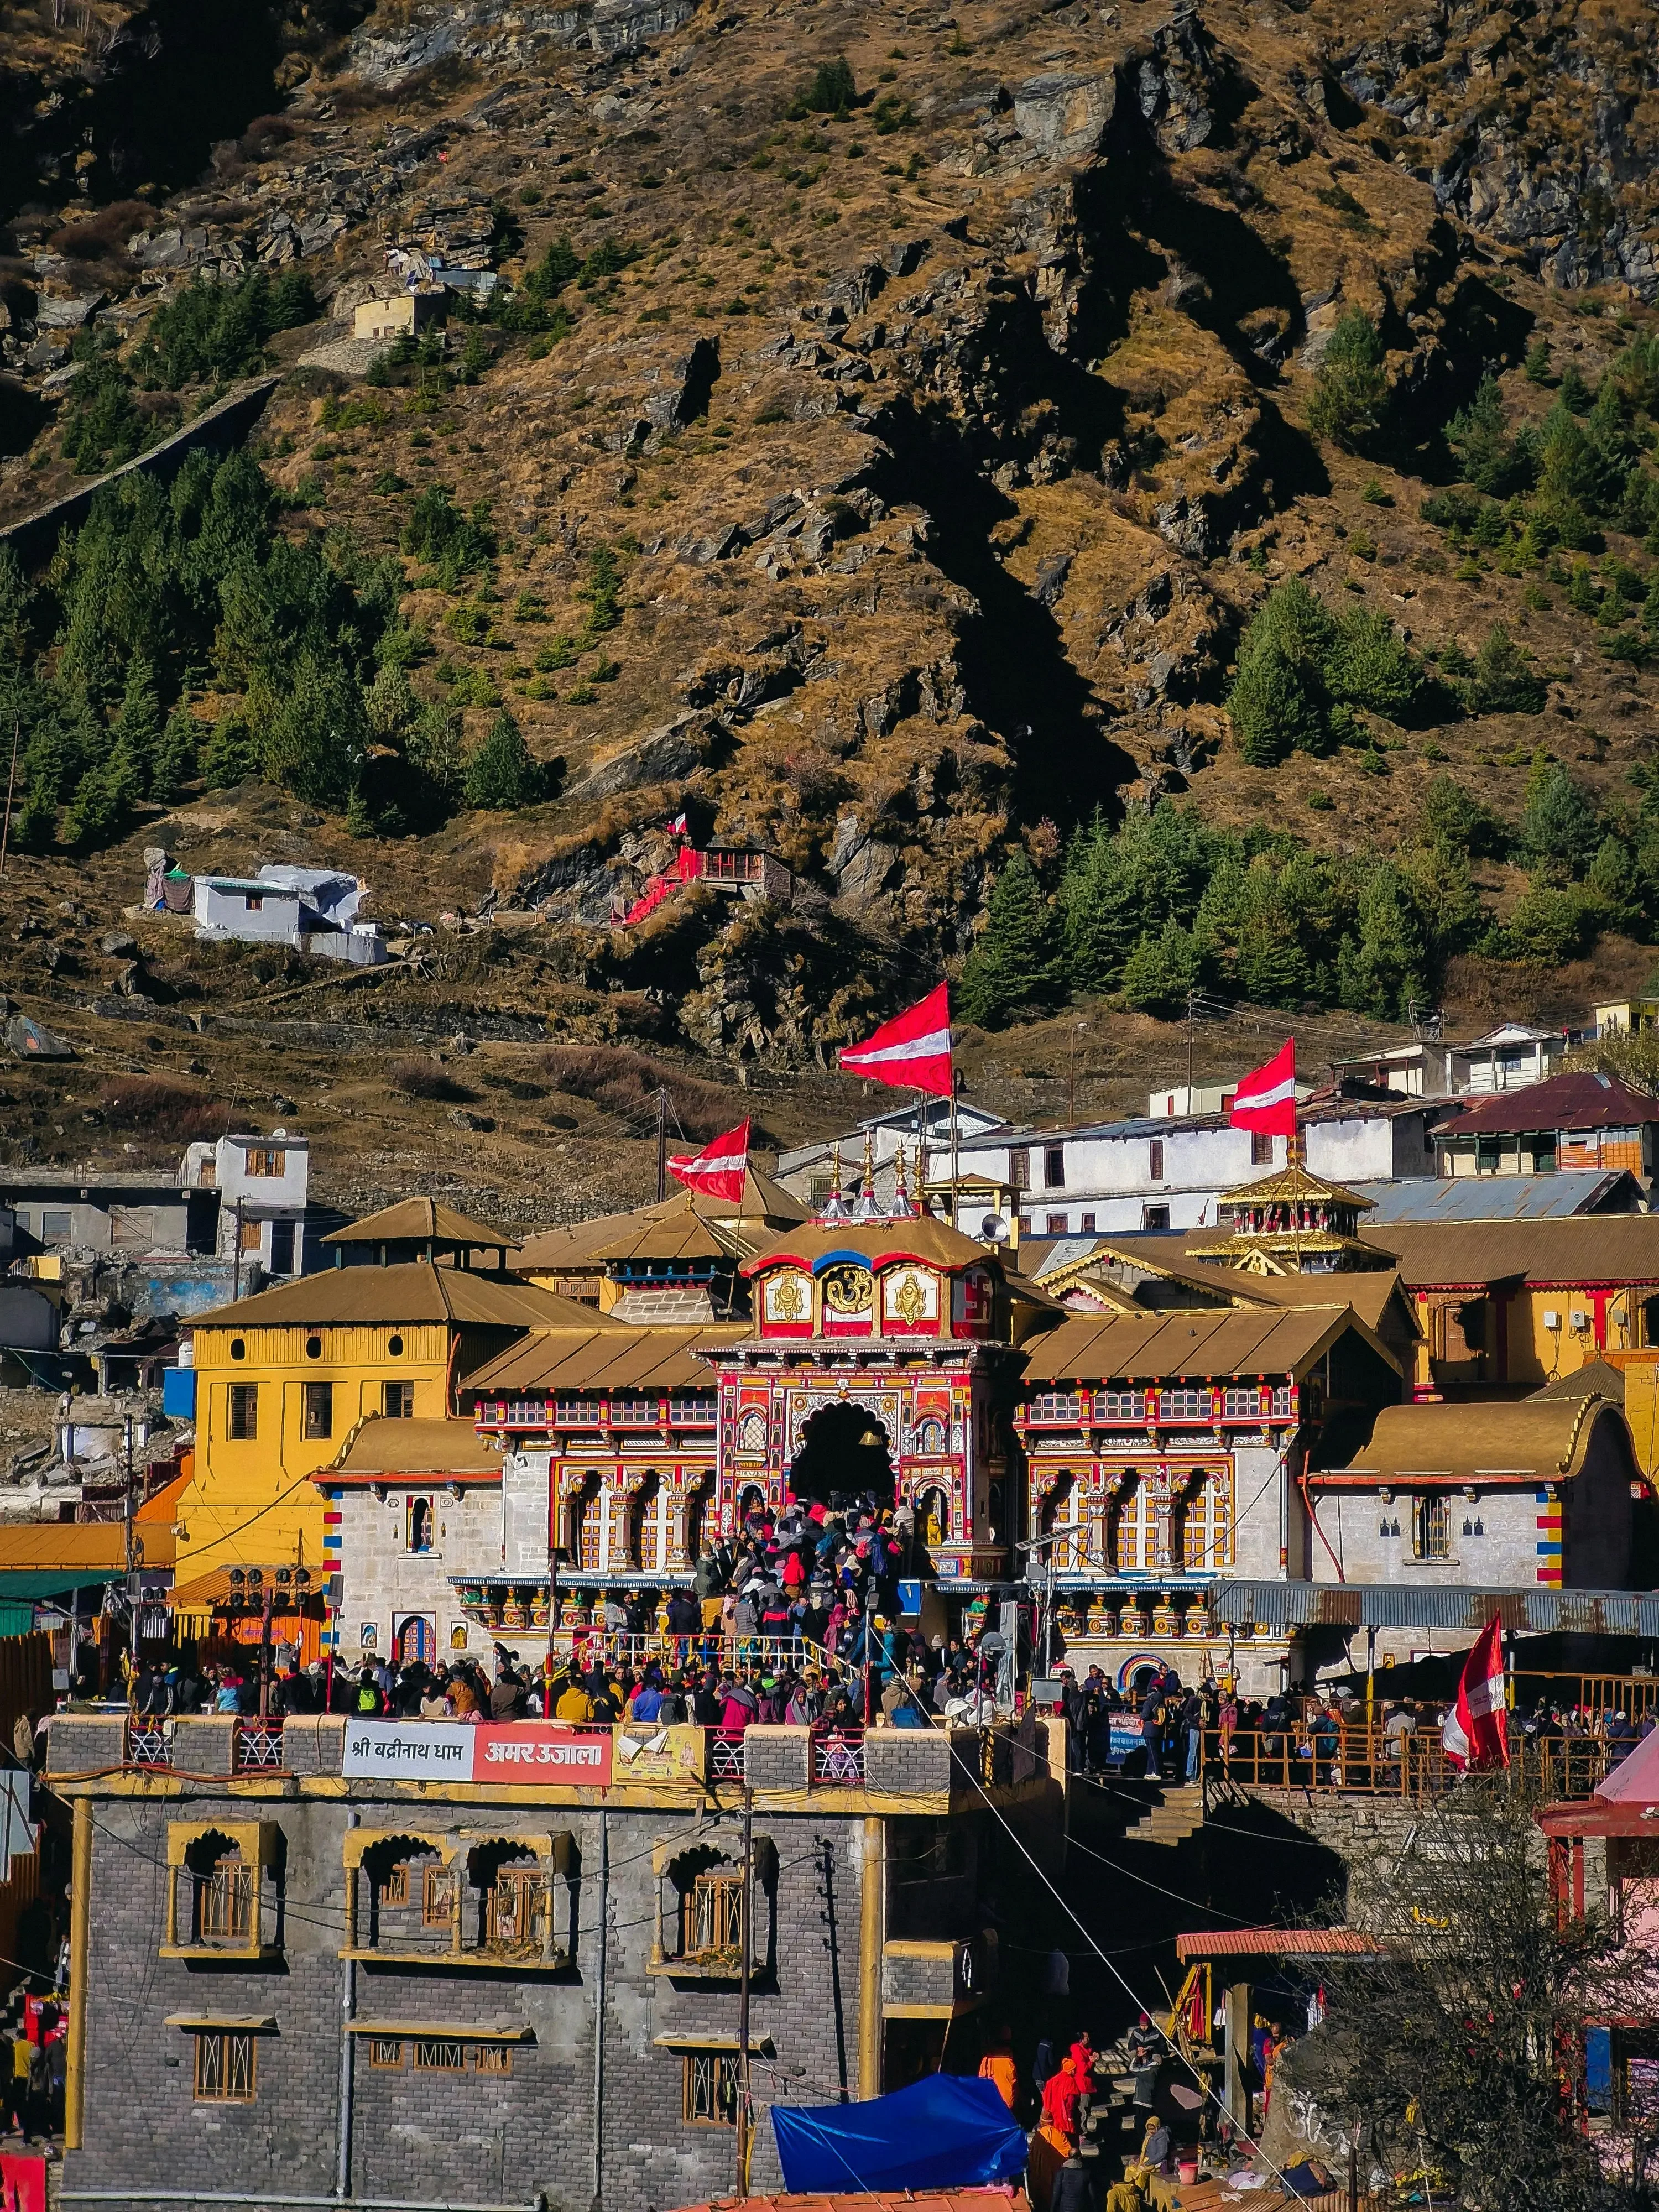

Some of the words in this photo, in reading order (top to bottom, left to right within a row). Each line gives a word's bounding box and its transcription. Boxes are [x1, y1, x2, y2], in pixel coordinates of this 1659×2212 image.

[351, 1737, 371, 1757] श्री
[374, 1738, 430, 1759] बद्रीनाथ
[434, 1744, 464, 1761] धाम
[484, 1742, 535, 1764] अमर
[536, 1744, 602, 1765] उजाला
